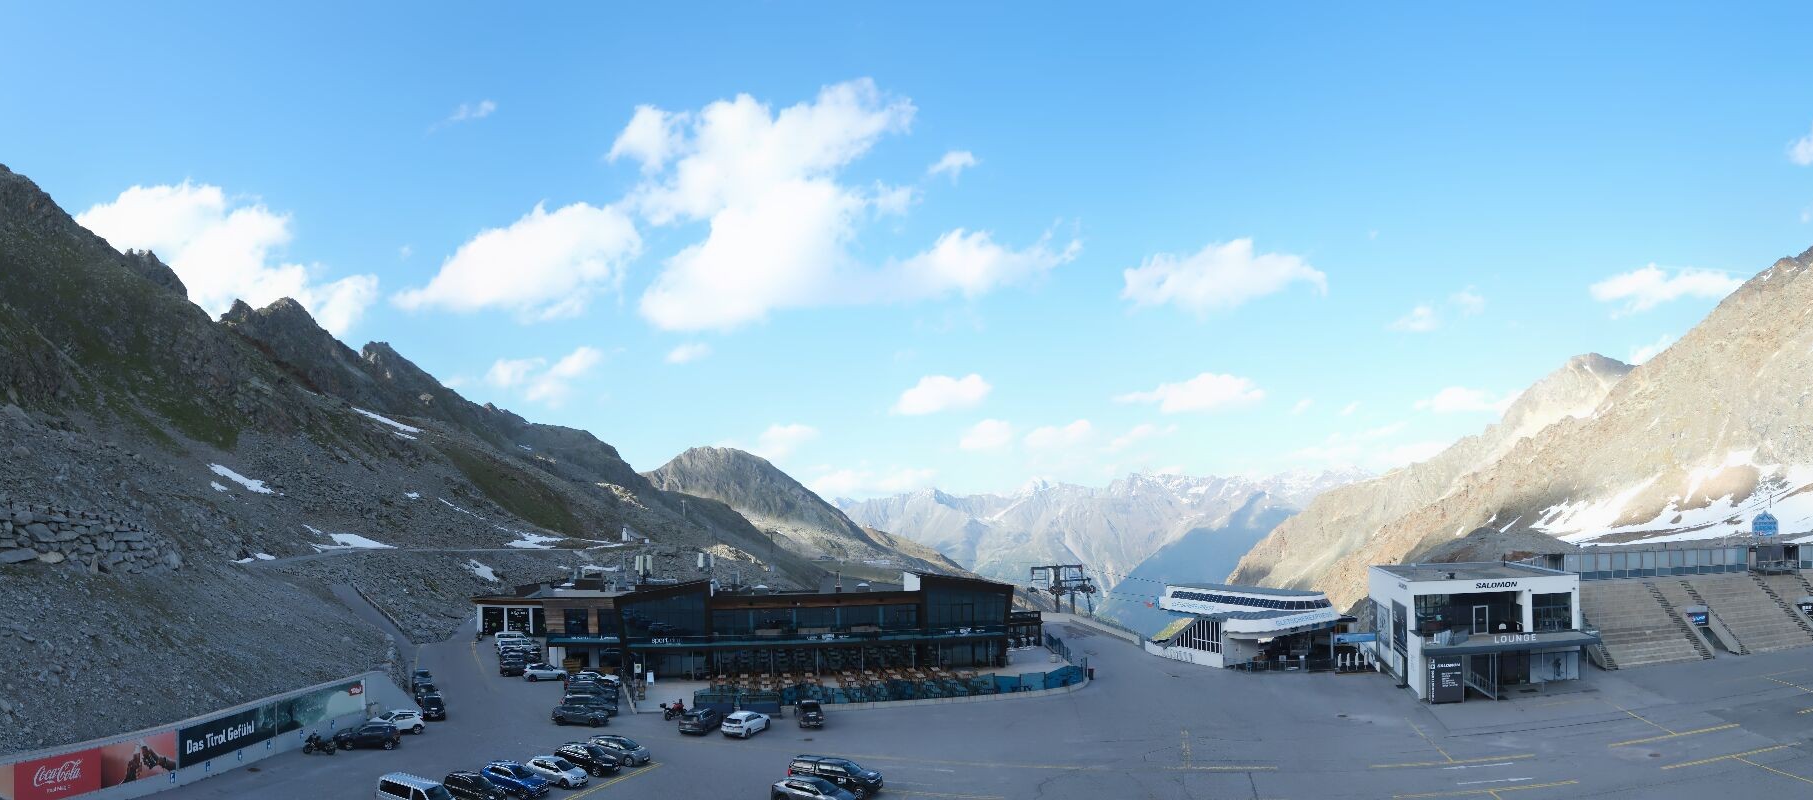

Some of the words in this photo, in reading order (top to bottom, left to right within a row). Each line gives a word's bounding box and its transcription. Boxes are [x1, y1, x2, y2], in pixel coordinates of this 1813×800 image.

[1475, 581, 1518, 589] SALOMON
[1494, 633, 1537, 644] LOUNGE
[186, 739, 205, 755] Das
[205, 728, 227, 748] Tirol
[227, 719, 255, 741] Gefühl
[33, 758, 84, 788] Coca-Cola
